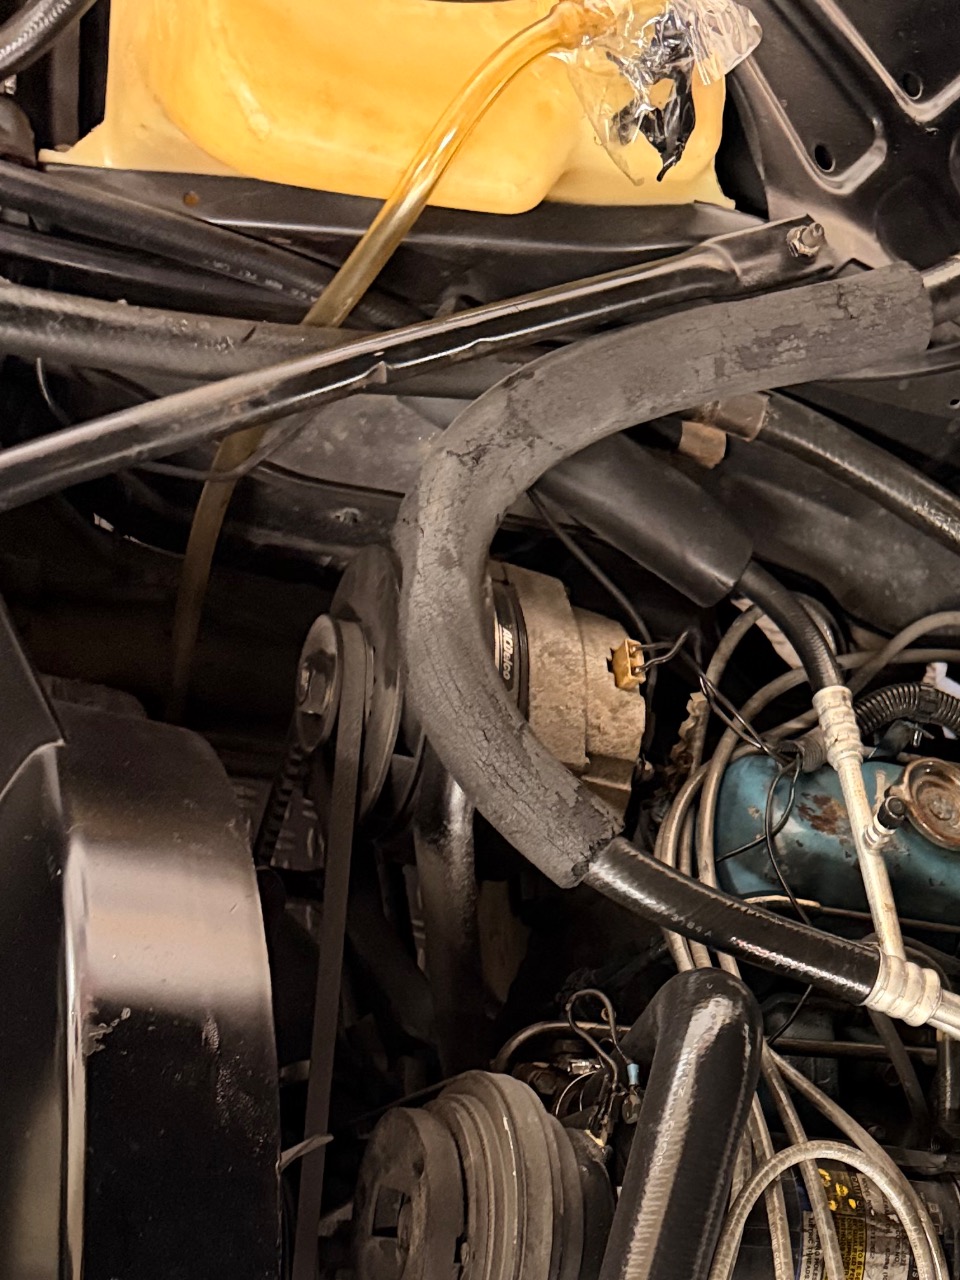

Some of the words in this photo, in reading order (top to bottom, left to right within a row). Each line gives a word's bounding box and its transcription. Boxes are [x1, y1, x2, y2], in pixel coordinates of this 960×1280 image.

[503, 627, 512, 679] ACDelco
[851, 1230, 859, 1266] QUALIFIED
[857, 1249, 863, 1258] TO
[856, 1261, 862, 1270] BE
